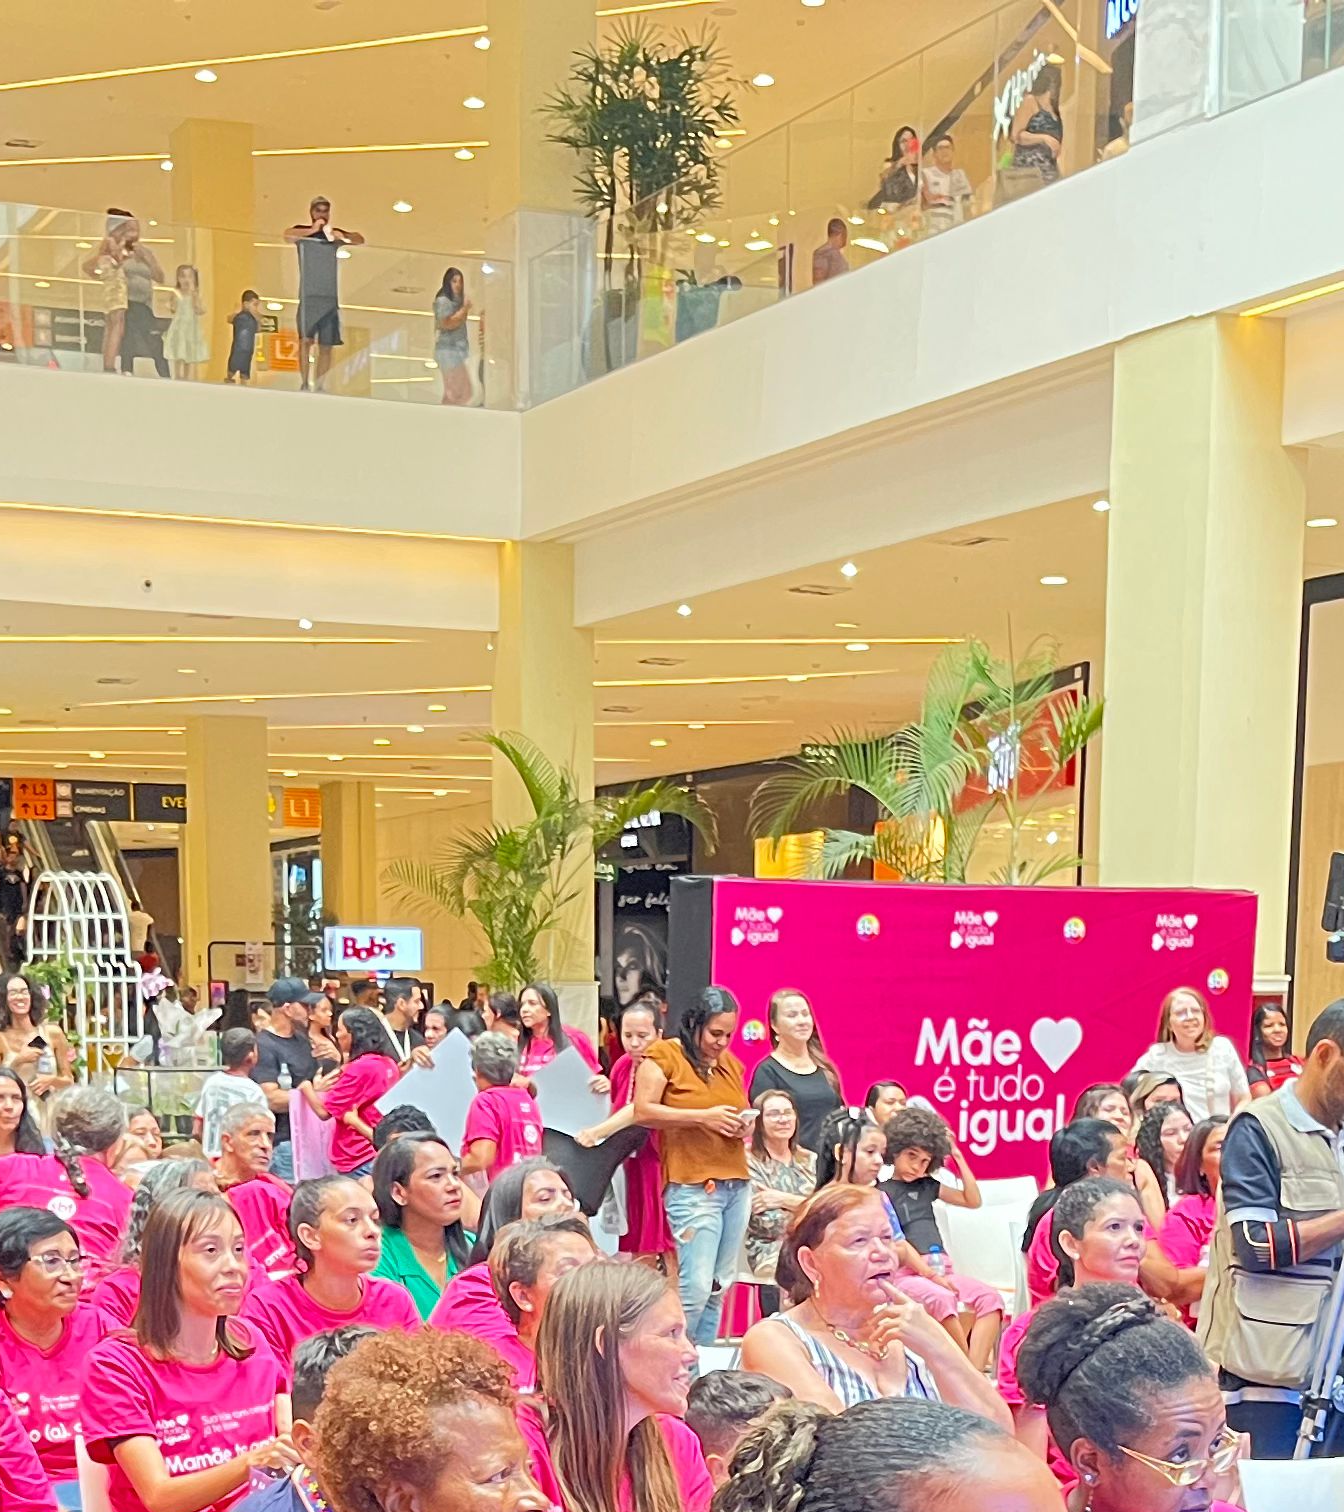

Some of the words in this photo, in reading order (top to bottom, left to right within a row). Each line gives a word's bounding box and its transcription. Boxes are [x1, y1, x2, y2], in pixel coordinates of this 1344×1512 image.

[32, 783, 48, 796] L3
[33, 803, 48, 816] L2
[161, 796, 187, 809] EVE
[290, 799, 310, 818] L1
[734, 906, 766, 922] Mãe
[954, 910, 983, 926] Mãe
[747, 928, 779, 946] igual
[342, 935, 396, 963] Bob's
[913, 1017, 1023, 1066] Mãe
[932, 1066, 956, 1103] é
[966, 1063, 1045, 1102] tudo
[958, 1093, 1066, 1157] igual
